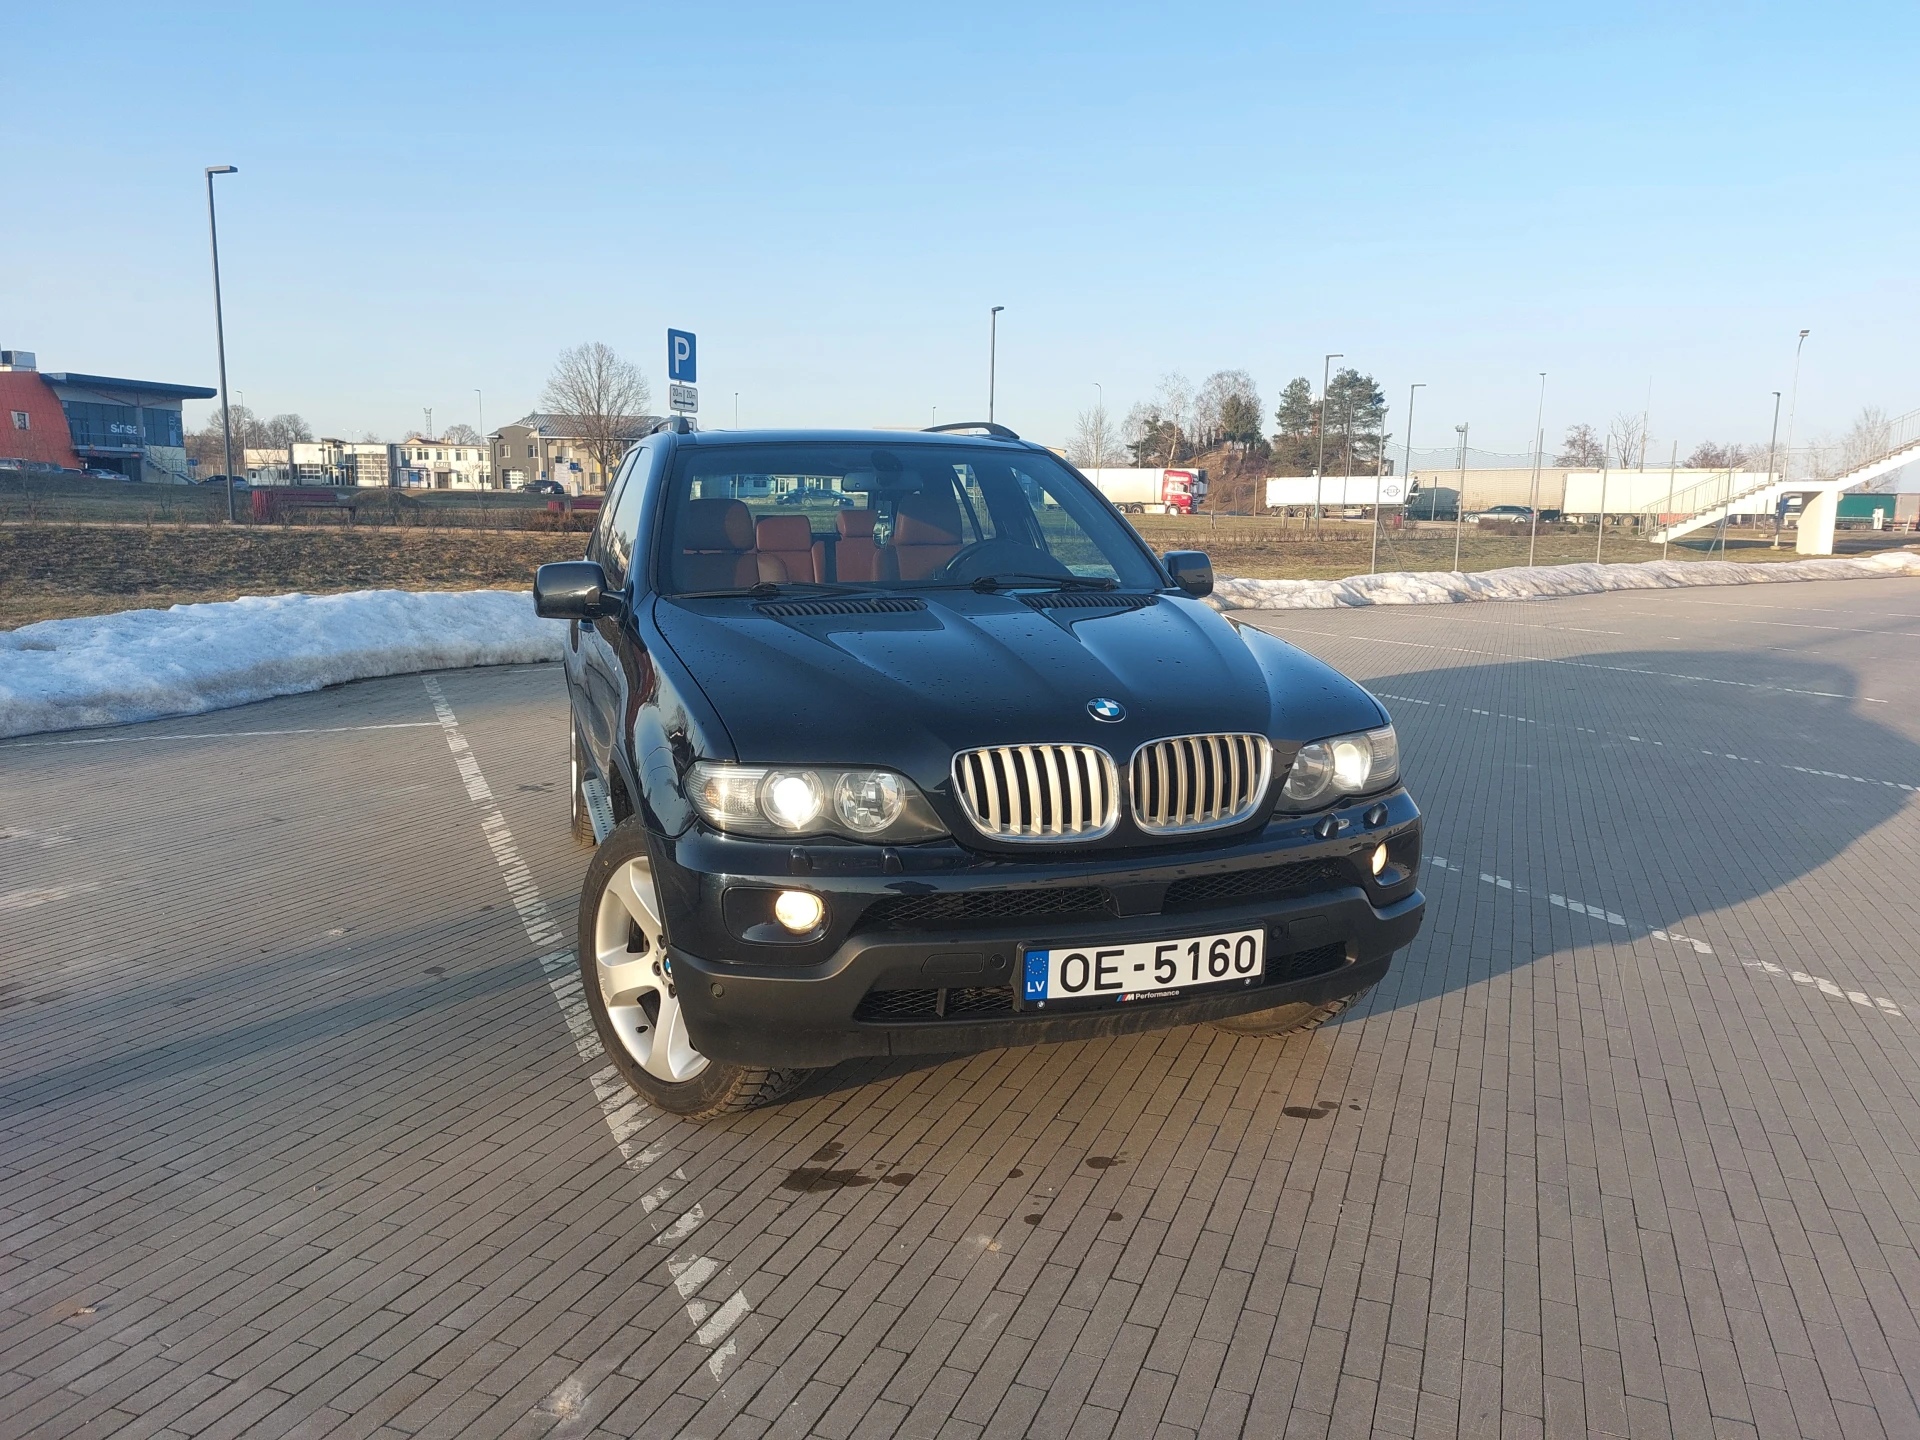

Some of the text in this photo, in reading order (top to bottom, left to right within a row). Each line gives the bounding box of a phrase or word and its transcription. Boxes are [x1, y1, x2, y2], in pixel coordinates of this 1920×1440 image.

[675, 336, 690, 374] P
[1060, 935, 1256, 993] OE-5160
[1027, 981, 1045, 993] LV
[1135, 990, 1180, 1000] Performance
